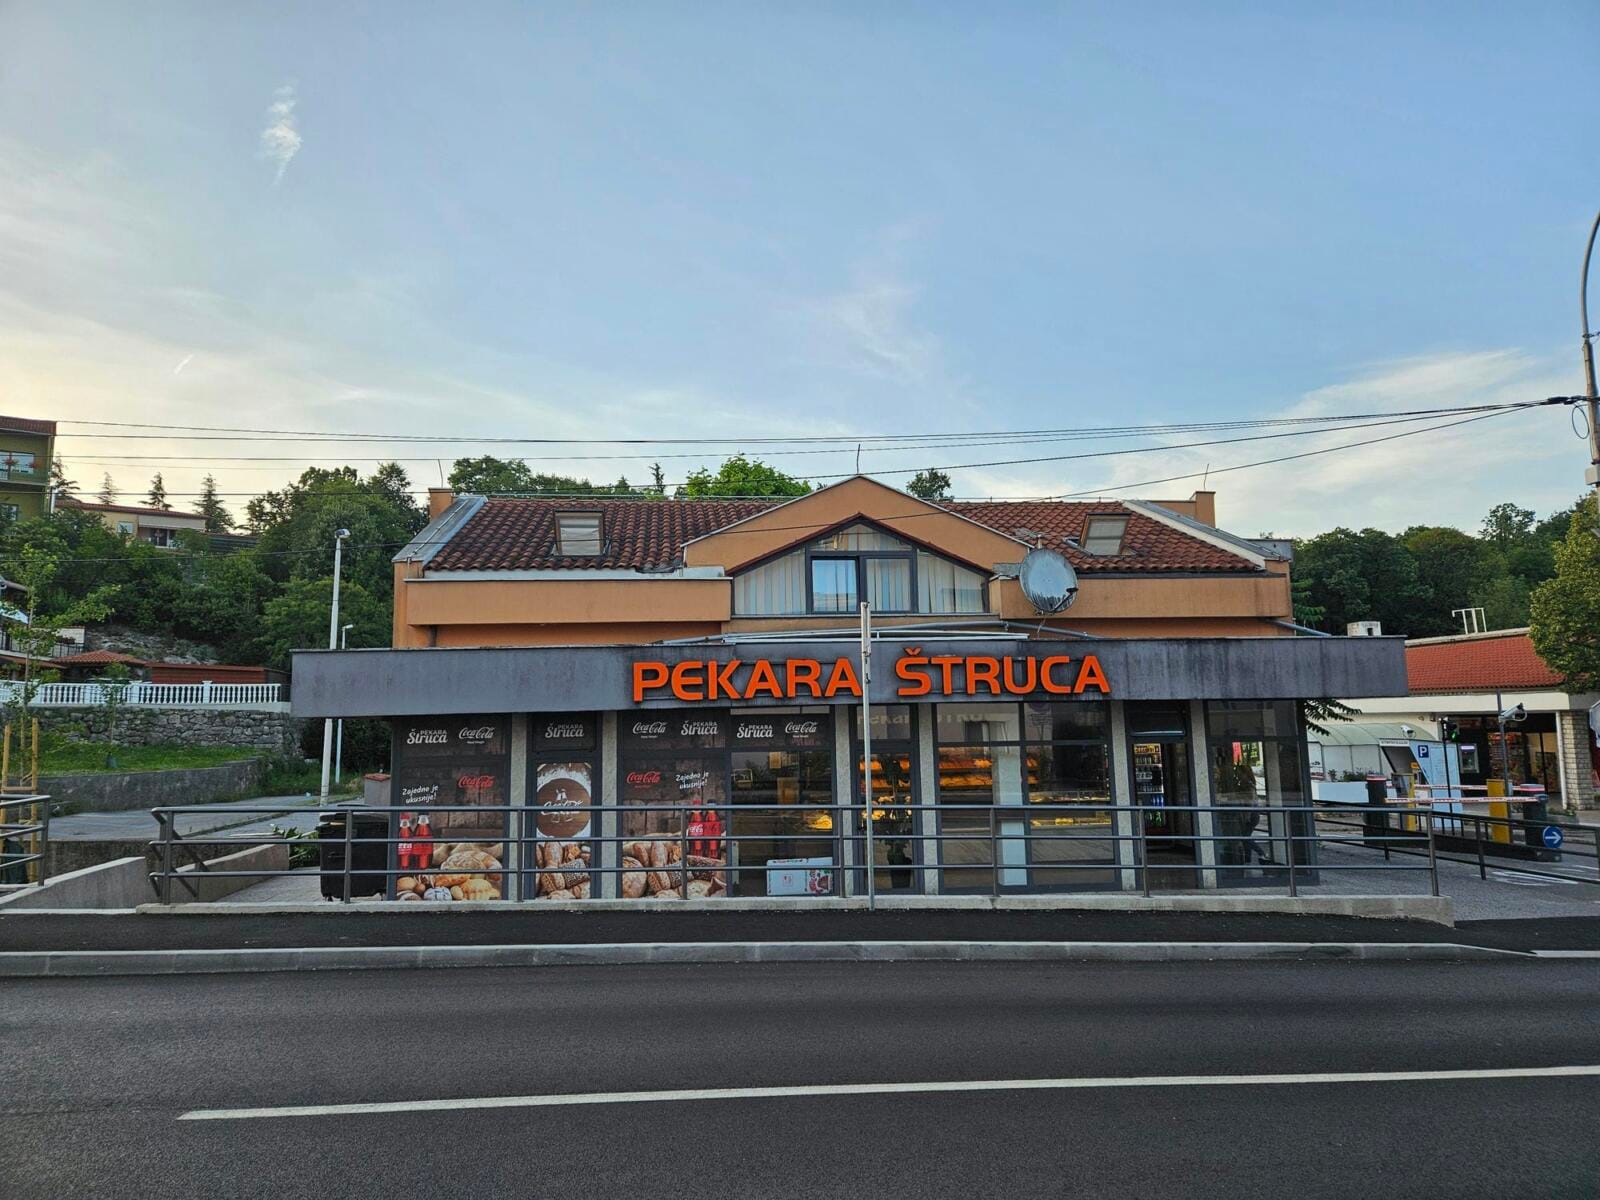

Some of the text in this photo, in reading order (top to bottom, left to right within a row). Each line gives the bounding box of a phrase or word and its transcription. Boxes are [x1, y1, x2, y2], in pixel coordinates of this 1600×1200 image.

[633, 647, 1111, 702] PEKARA ŠTRUCA
[407, 728, 448, 744] Štruca
[544, 722, 584, 738] Štruca
[681, 720, 719, 736] Štruca
[736, 723, 774, 738] Štruca
